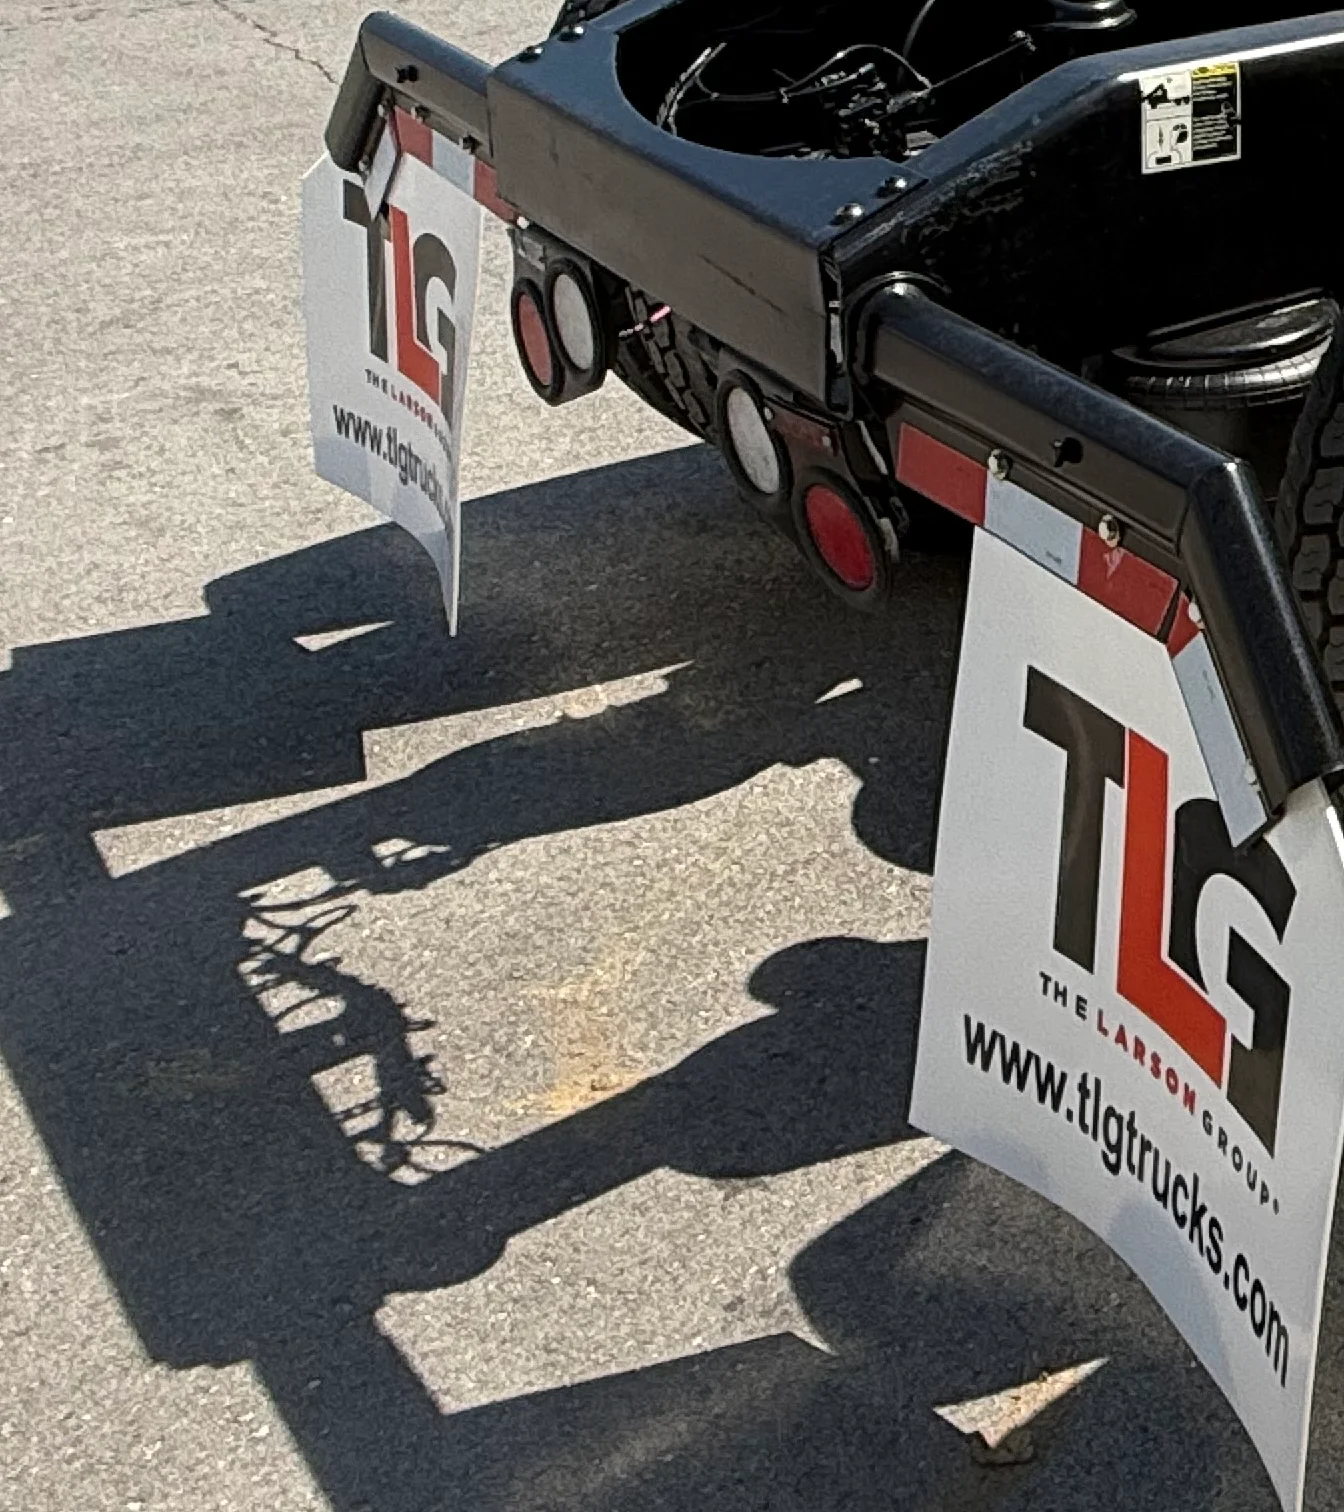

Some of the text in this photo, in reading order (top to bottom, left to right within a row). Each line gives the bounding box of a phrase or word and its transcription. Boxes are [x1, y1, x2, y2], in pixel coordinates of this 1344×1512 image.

[343, 179, 456, 431] TLG
[365, 368, 388, 395] THE
[1023, 664, 1296, 1158] TLG
[1039, 971, 1088, 1021] THE
[1097, 1008, 1196, 1116] LARSON
[963, 1013, 1290, 1386] www.tlgtrucks.com
